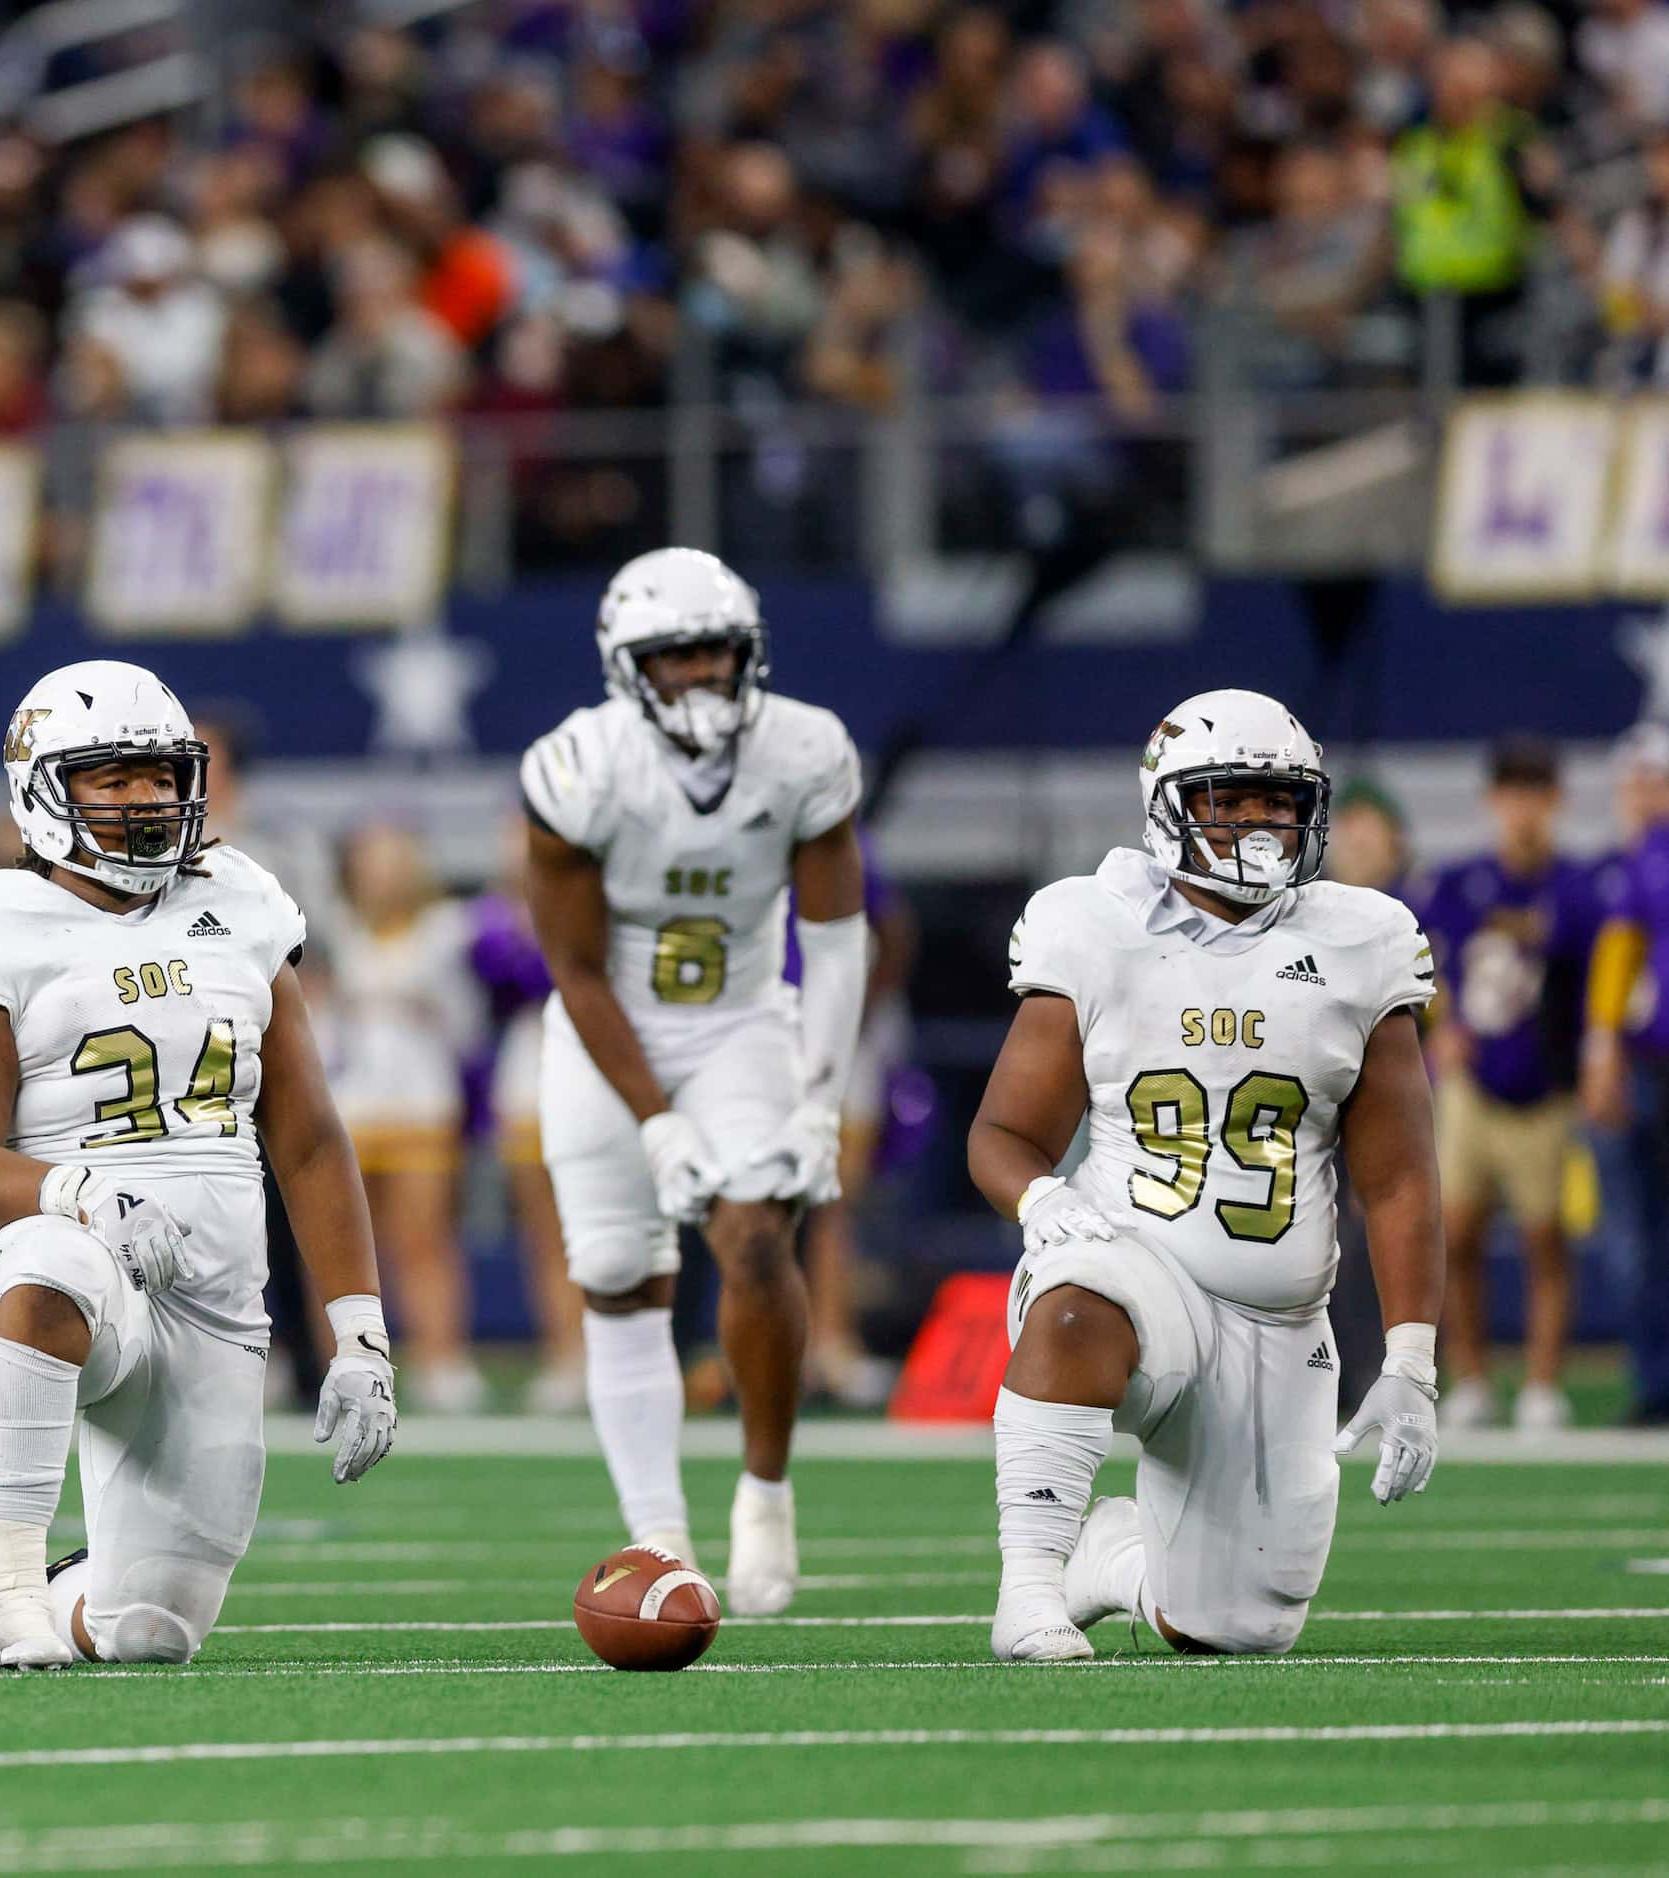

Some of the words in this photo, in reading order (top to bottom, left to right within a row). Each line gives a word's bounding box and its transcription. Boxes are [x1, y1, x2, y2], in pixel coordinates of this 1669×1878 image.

[134, 727, 158, 736] schutt
[664, 867, 735, 897] SOC
[187, 926, 232, 937] adidas
[649, 914, 733, 1005] 6
[1276, 969, 1327, 986] adidas
[113, 959, 193, 1005] SOC
[1181, 1008, 1266, 1050] SOC
[70, 1017, 239, 1149] 34
[1125, 1068, 1310, 1245] 99
